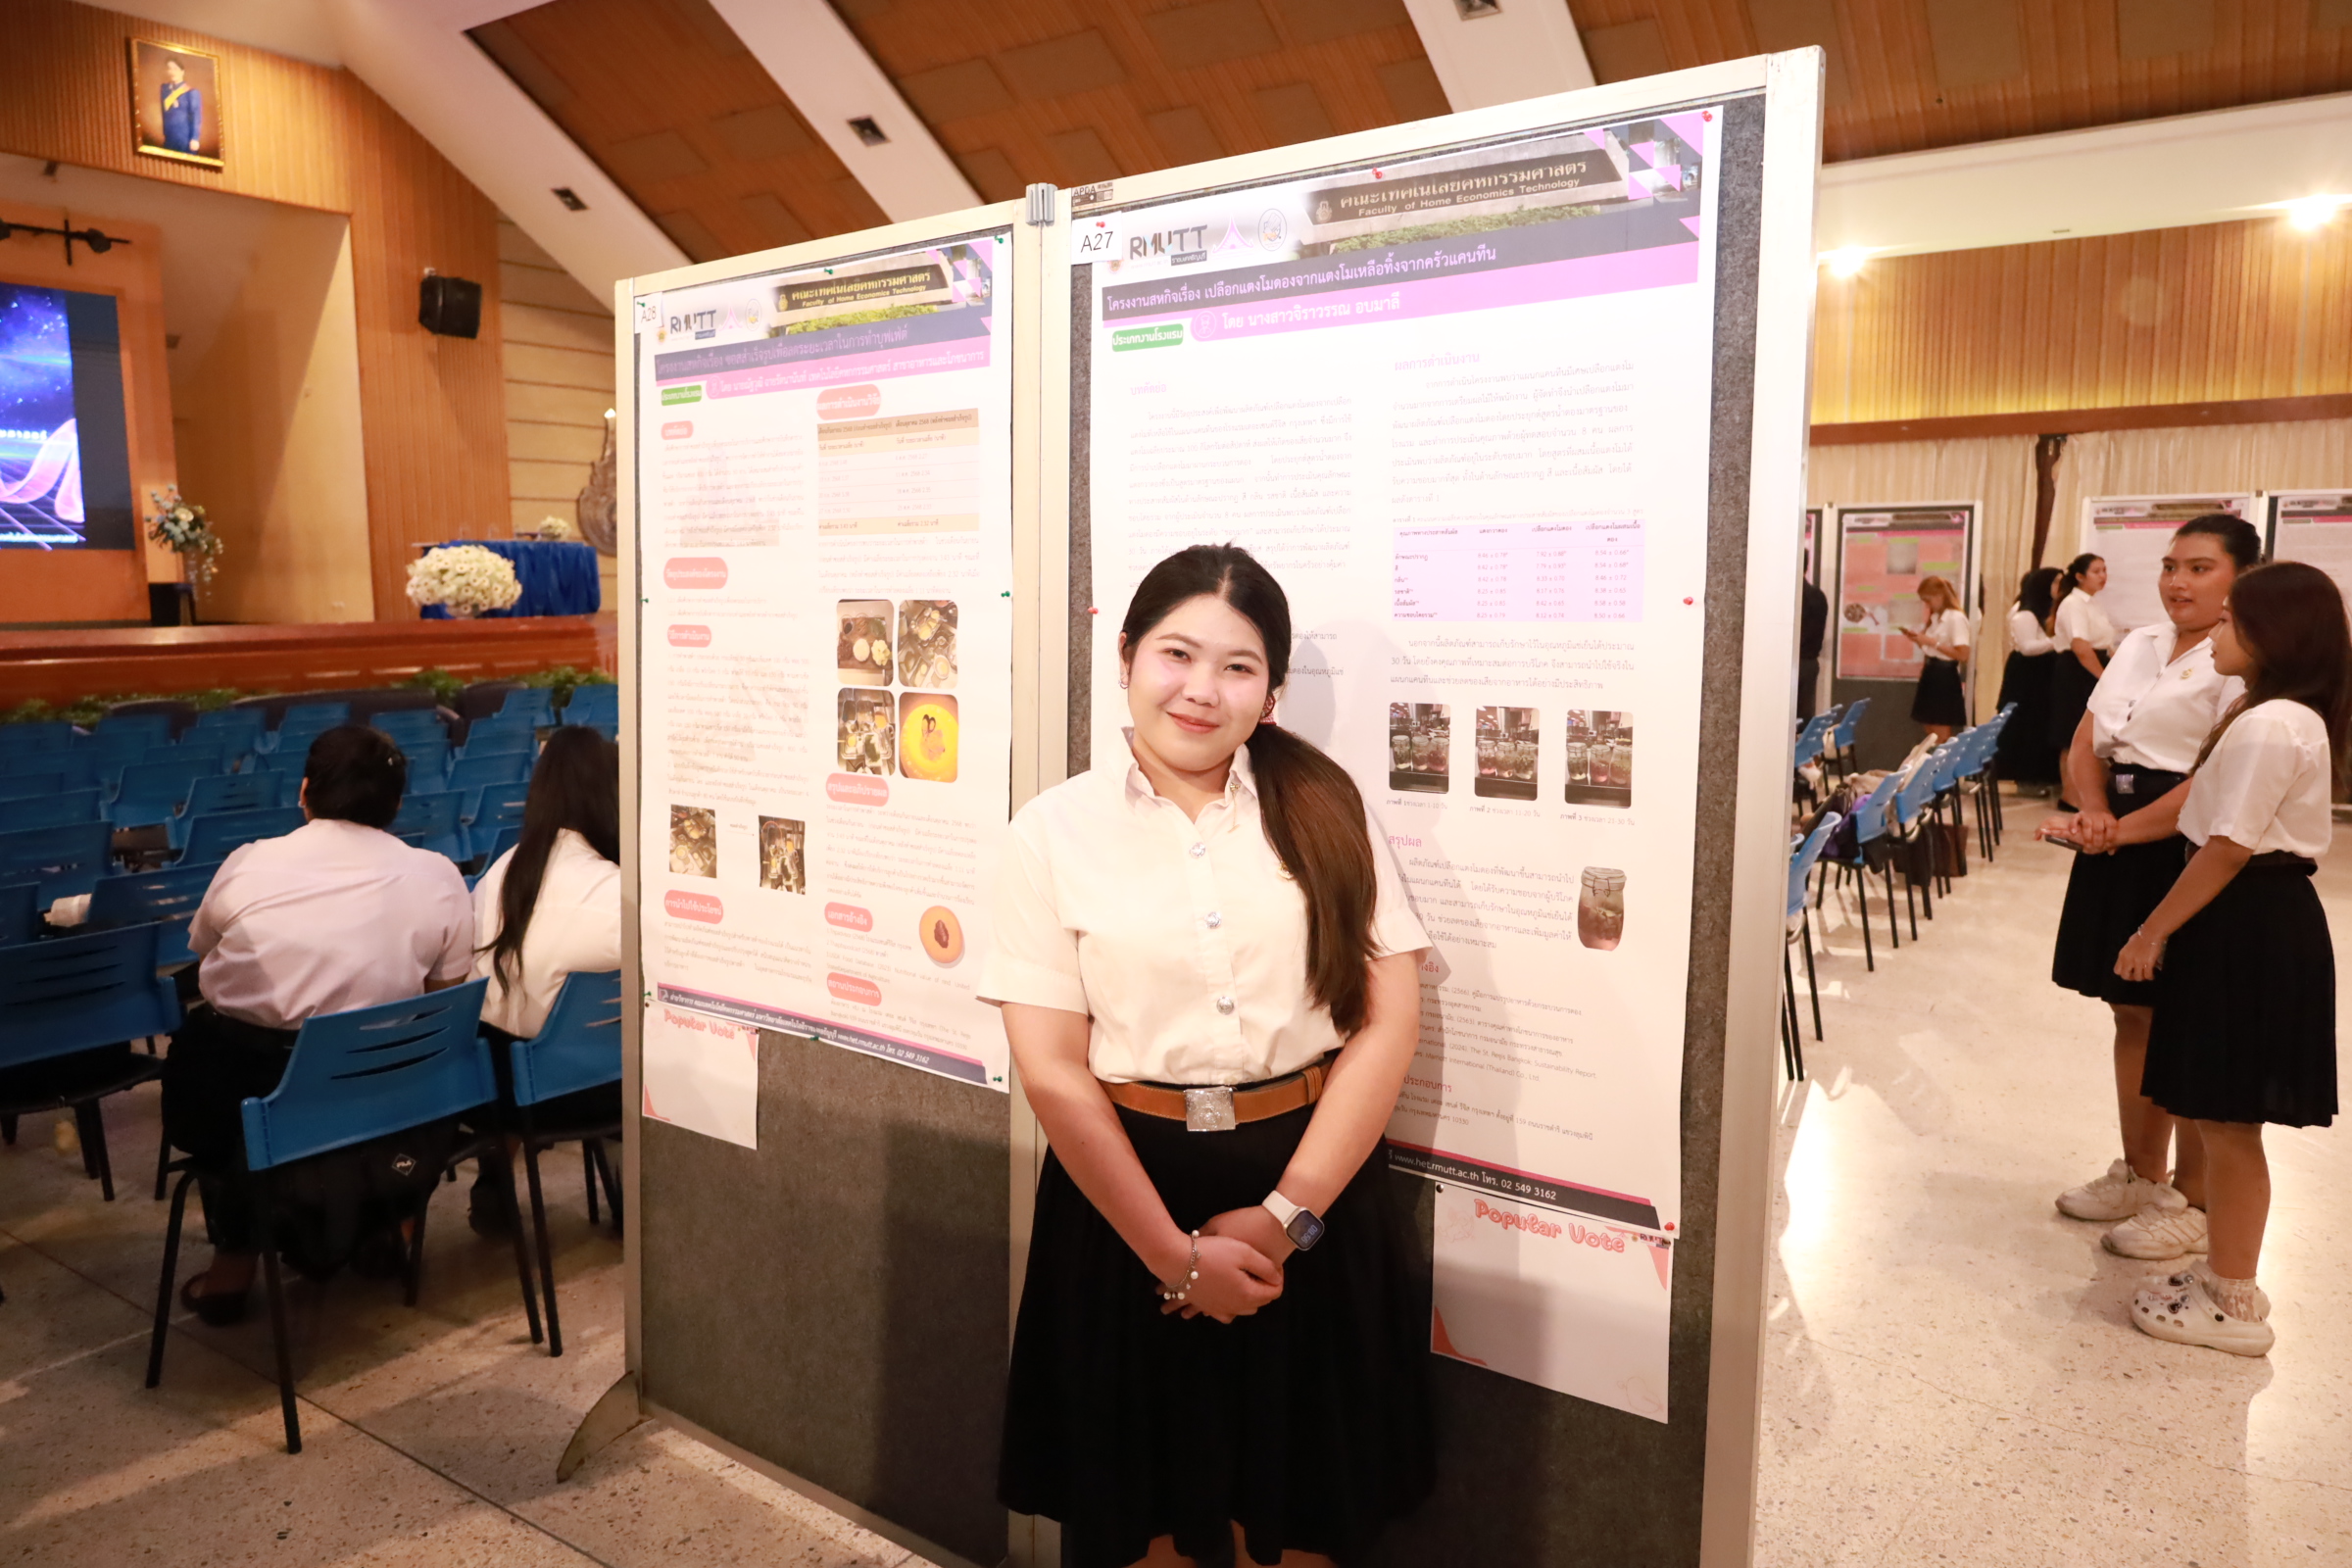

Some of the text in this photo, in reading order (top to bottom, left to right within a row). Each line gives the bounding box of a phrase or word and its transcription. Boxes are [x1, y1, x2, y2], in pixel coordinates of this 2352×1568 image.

[1358, 177, 1580, 217] Faculty of Home Economics Technology
[1081, 231, 1114, 253] A27
[1130, 224, 1207, 260] RMUTT
[802, 284, 927, 308] Faculty of Home Economics Technology
[1107, 282, 1200, 312] โครงงานสหกิจเรื่อง
[640, 306, 657, 323] A28
[1223, 292, 1400, 329] โดย นางสาวจิราวรรณ อบมาลี
[1395, 351, 1481, 371] ผลการดำเนินงาน
[1130, 382, 1167, 396] บทคัดย่อ
[1608, 424, 1634, 434] ผลการ
[1187, 443, 1199, 452] 100
[1608, 462, 1632, 474] โดยได้
[1392, 657, 1399, 665] 30
[1402, 656, 1411, 665] วัน
[1387, 798, 1402, 807] ภาพที่
[1469, 805, 1486, 813] ภาพที่
[1560, 812, 1577, 821] ภาพที่
[1388, 835, 1422, 849] สรุปผล
[663, 1008, 707, 1034] Popular
[710, 1020, 735, 1041] Vote
[897, 1048, 905, 1058] 02
[905, 1051, 915, 1061] 549
[915, 1054, 930, 1064] 3162
[1471, 1046, 1481, 1055] The
[1492, 1051, 1505, 1061] Regis
[1535, 1060, 1574, 1074] Sustainability
[1449, 1056, 1485, 1070] International
[1486, 1063, 1515, 1077] (Thailand)
[1529, 1072, 1541, 1082] Ltd.
[1452, 1115, 1470, 1126] 10330
[1516, 1116, 1527, 1125] 159
[1395, 1153, 1479, 1181] www.het.rmutt.ac.th
[1482, 1172, 1498, 1187] โทร.
[1501, 1180, 1512, 1190] 02
[1515, 1183, 1532, 1195] 549
[1534, 1187, 1557, 1200] 3162
[1473, 1198, 1562, 1238] Popular
[1568, 1222, 1626, 1253] Vote
